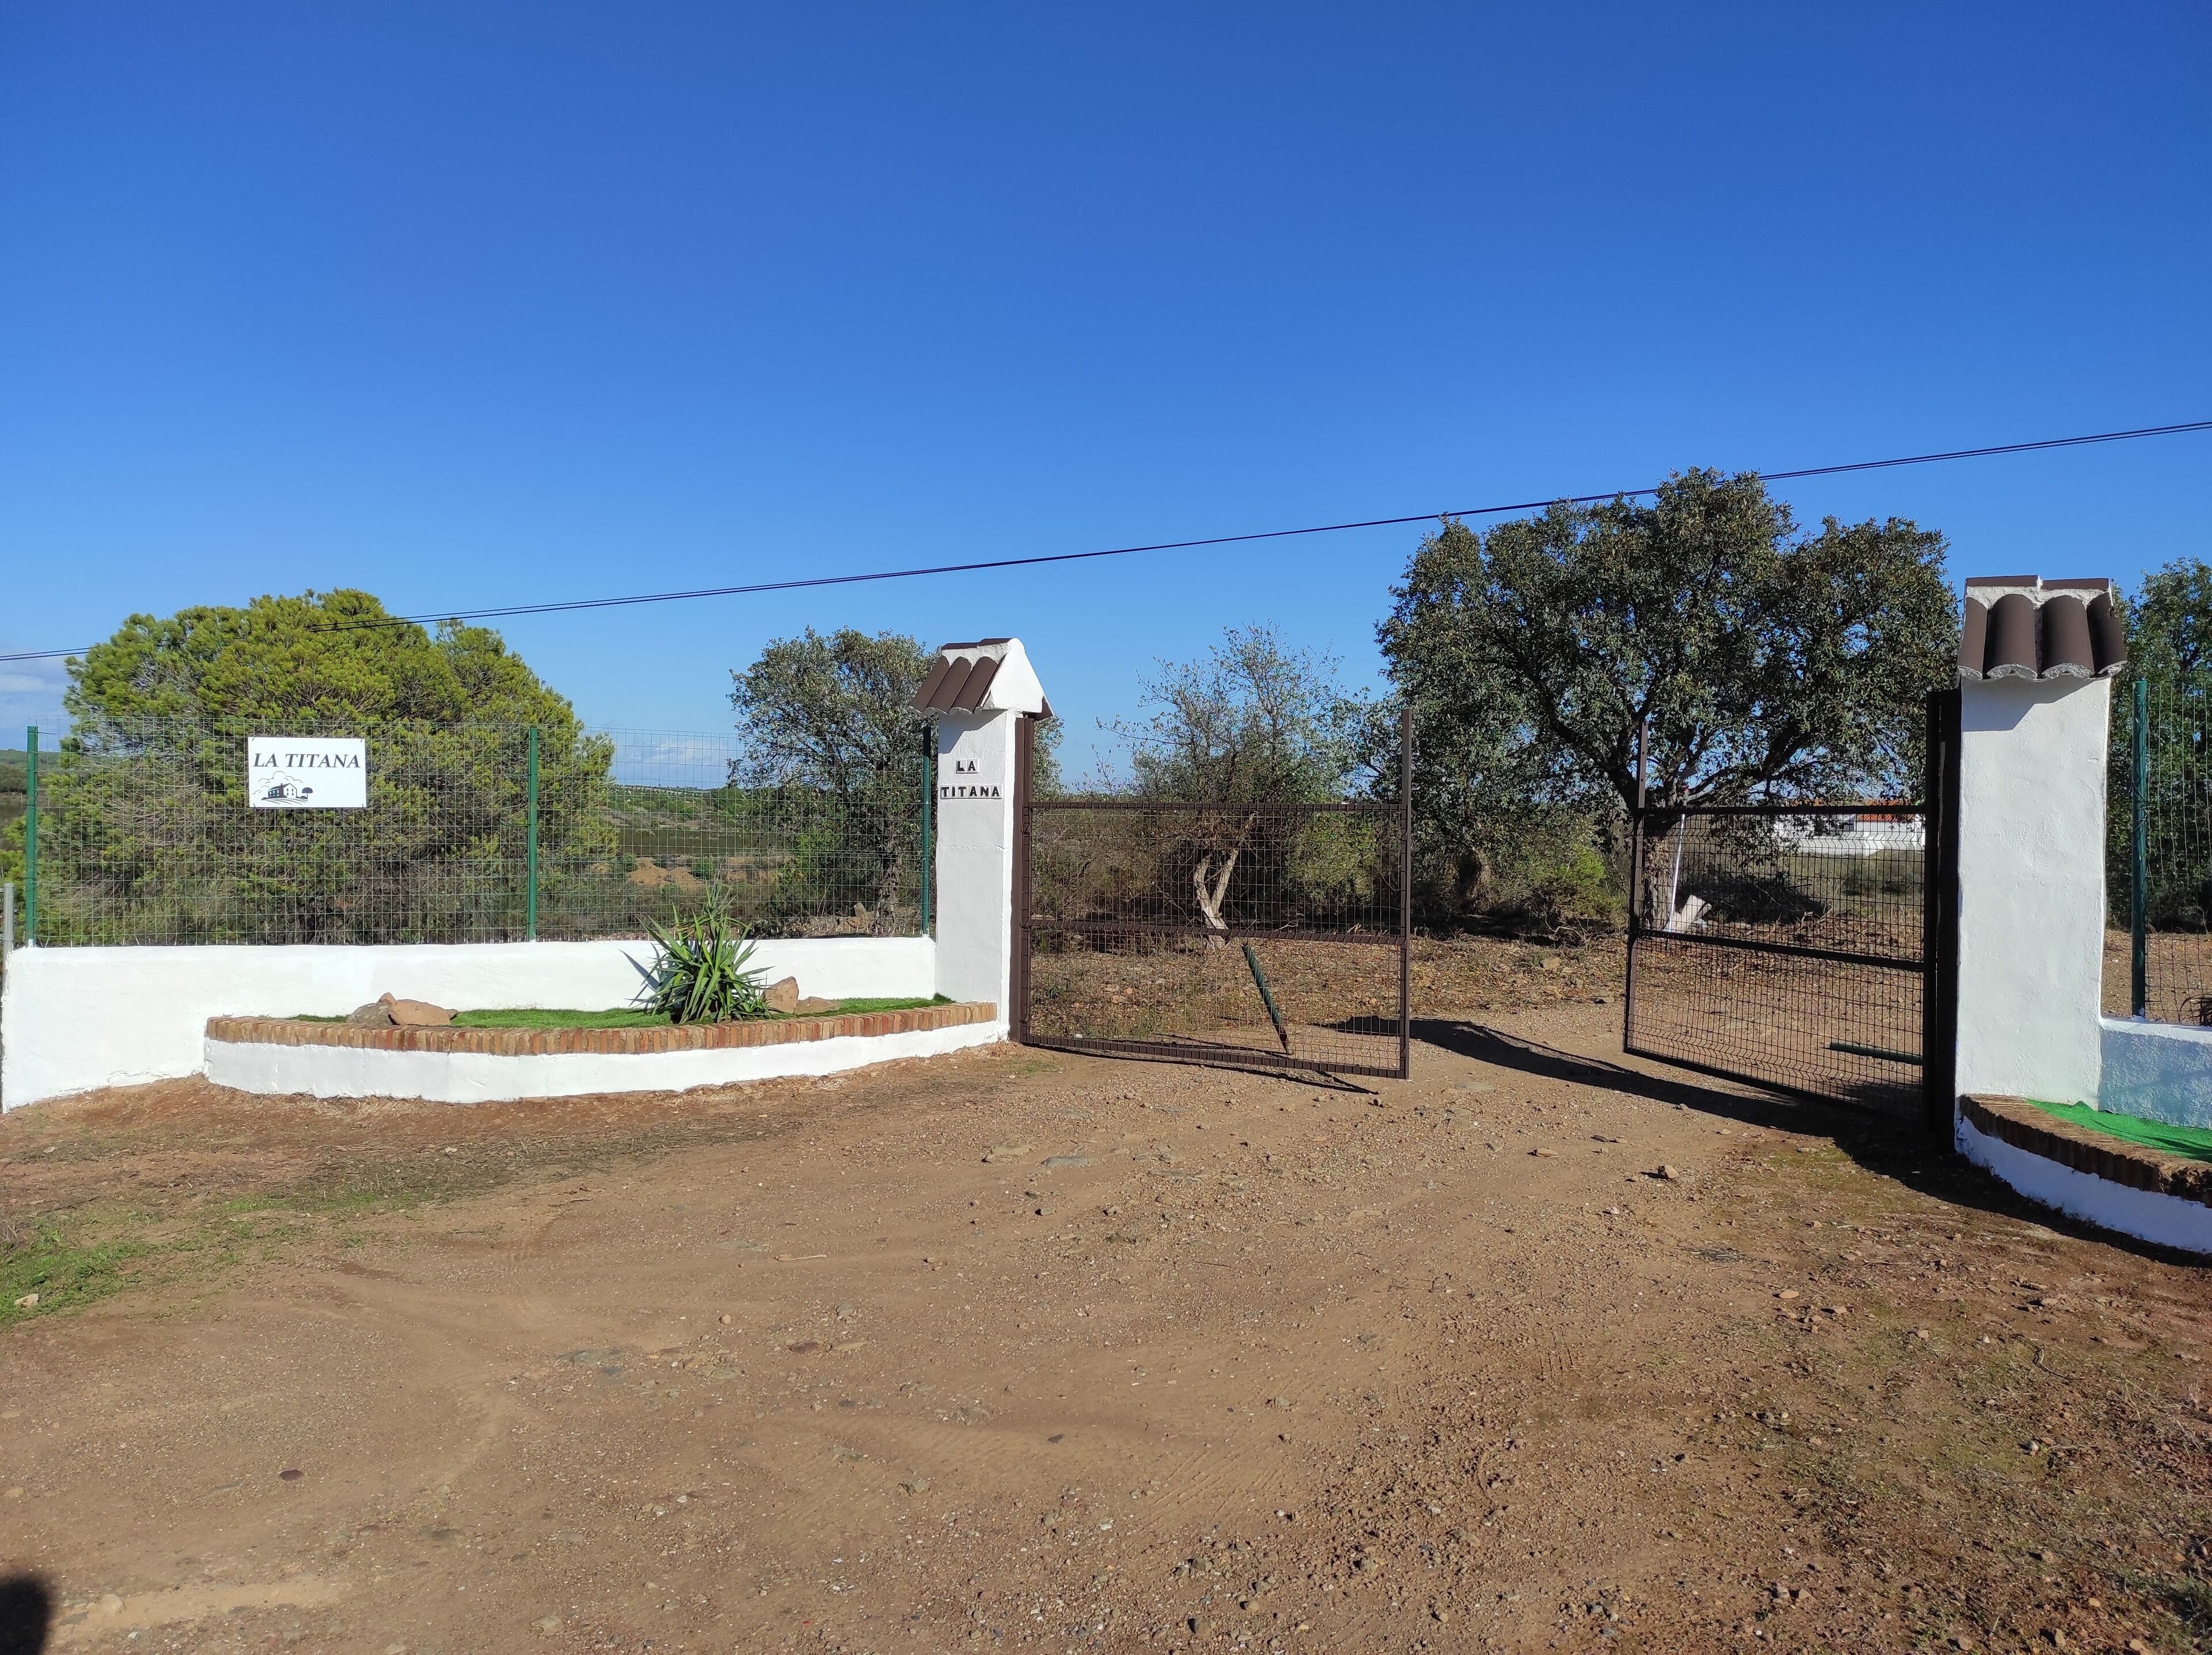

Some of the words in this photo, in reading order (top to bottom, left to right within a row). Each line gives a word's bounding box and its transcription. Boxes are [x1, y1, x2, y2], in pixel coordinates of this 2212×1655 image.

[252, 753, 279, 767] LA
[285, 753, 361, 768] TITANA
[957, 760, 976, 771] LA
[942, 786, 999, 797] TITANA
